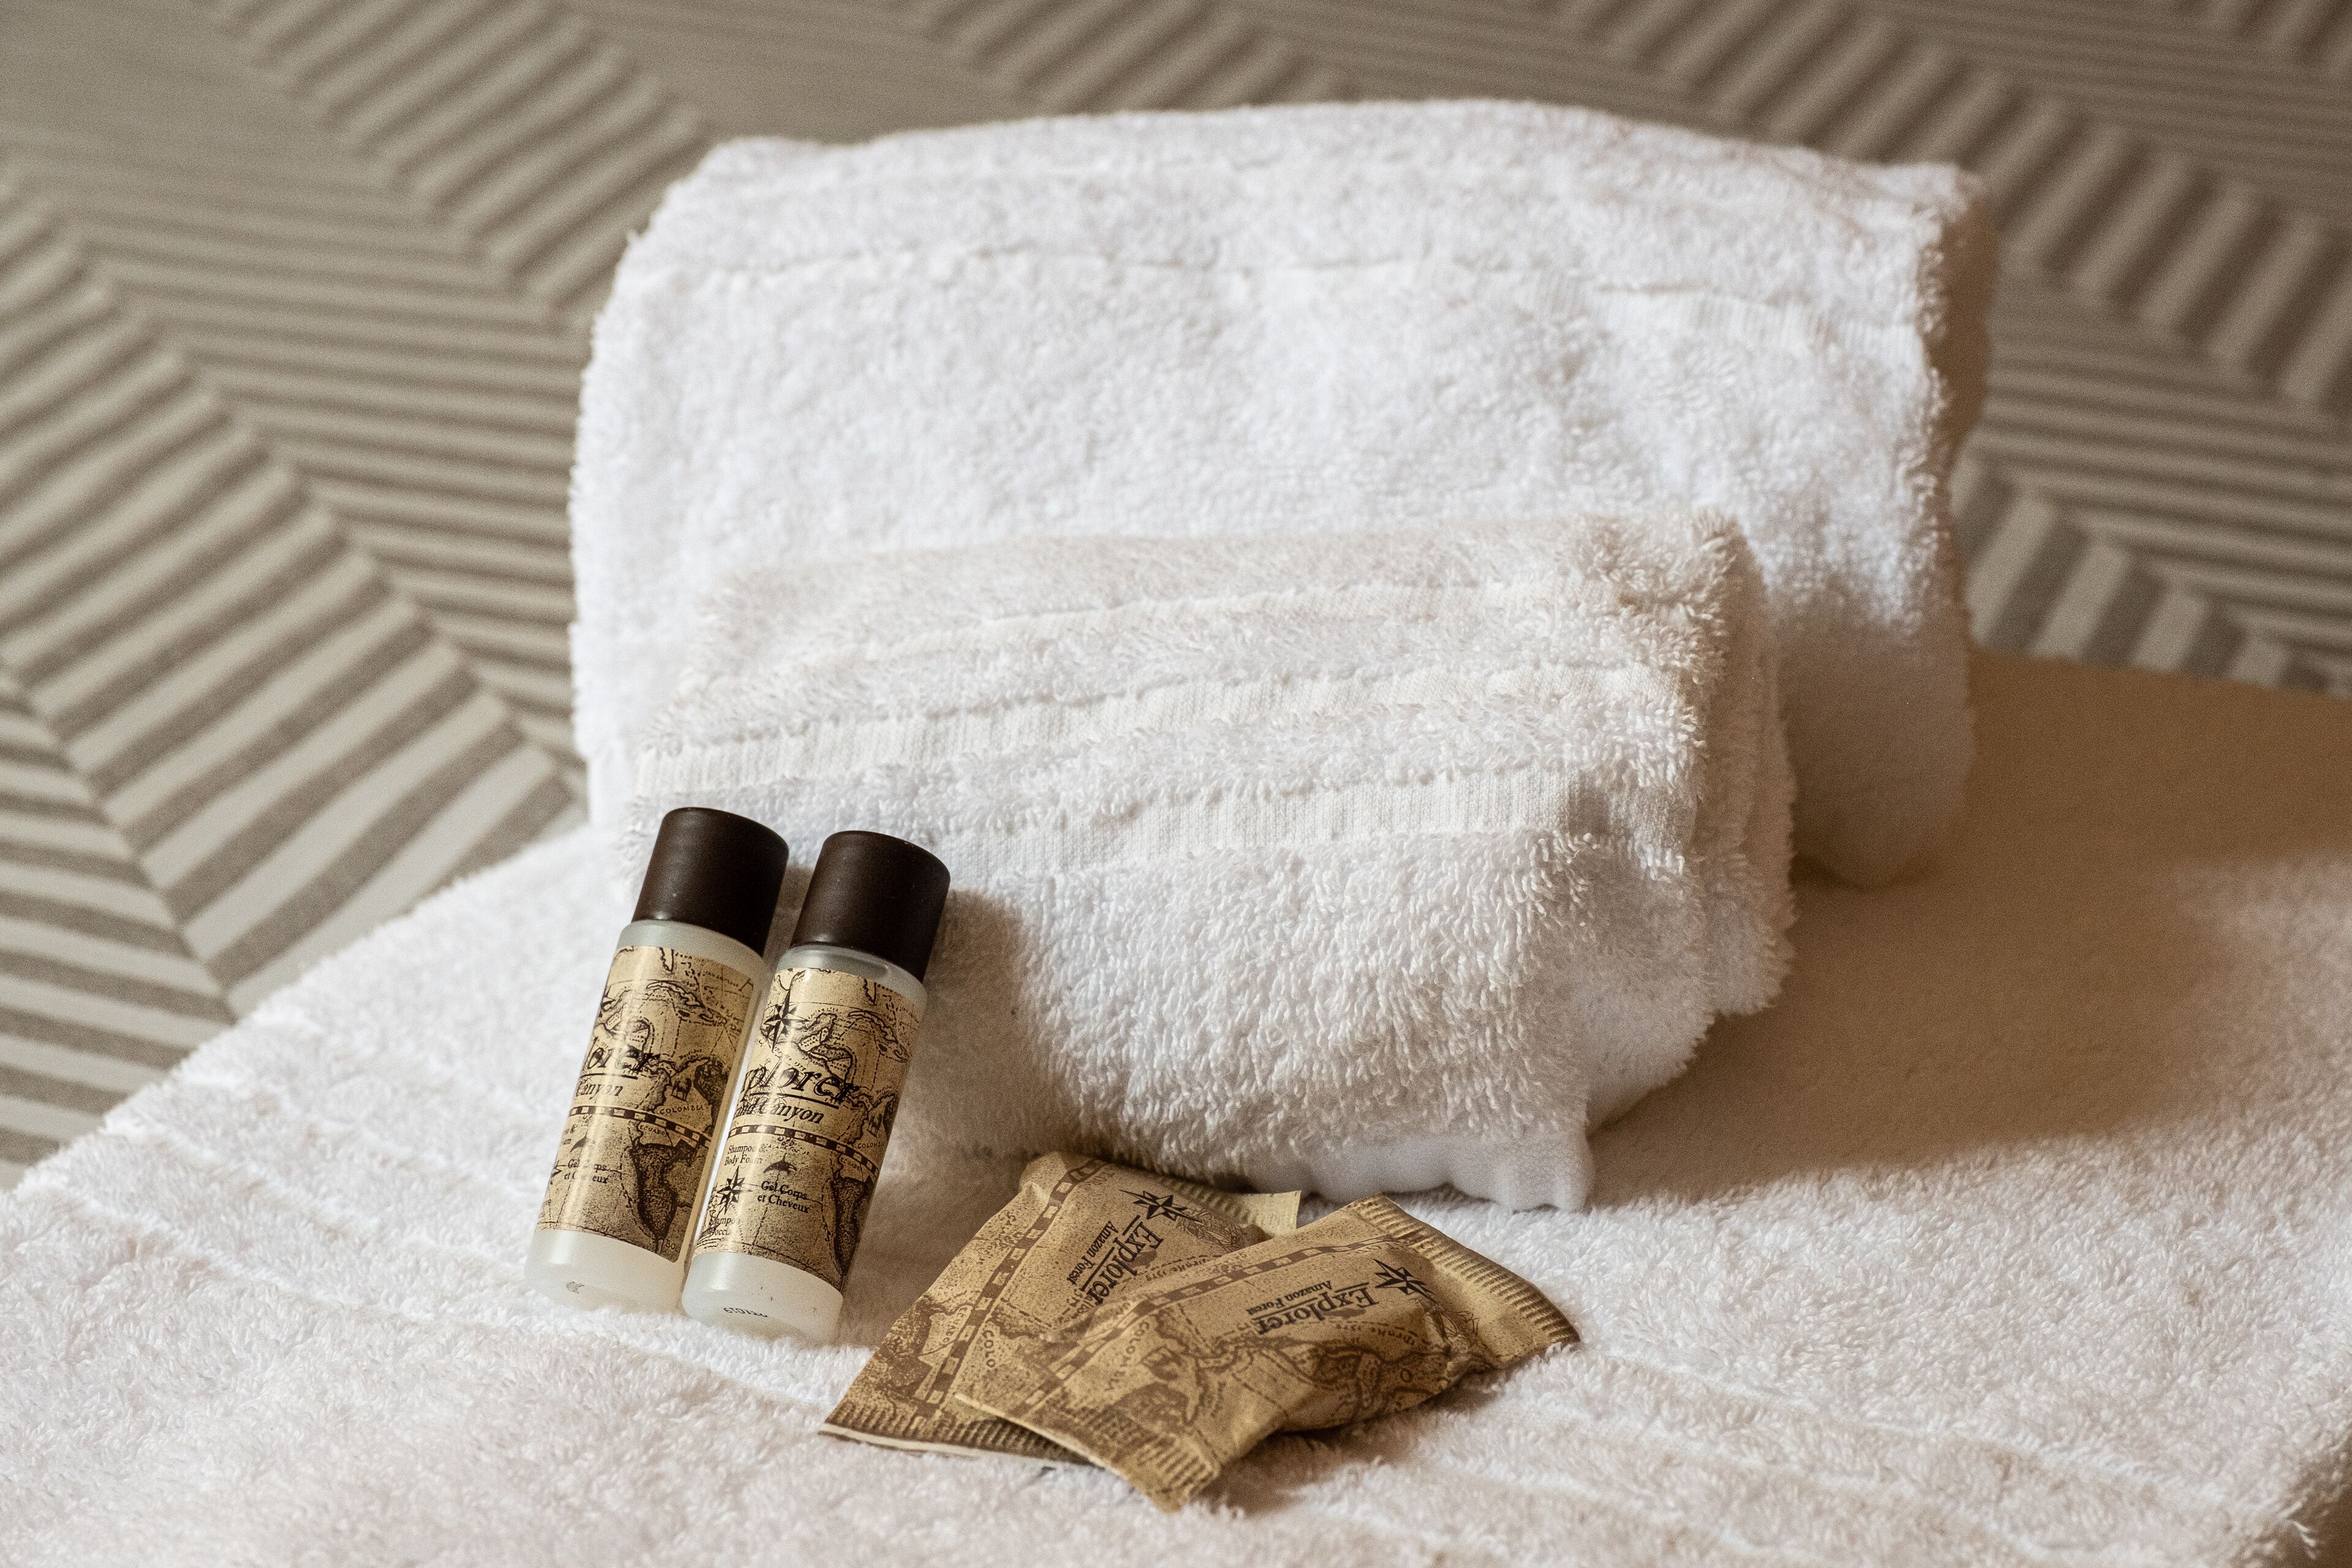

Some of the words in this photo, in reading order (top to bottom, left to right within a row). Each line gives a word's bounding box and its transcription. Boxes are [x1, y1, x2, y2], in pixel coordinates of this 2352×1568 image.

[660, 1104, 704, 1114] COLOMBIA
[759, 1100, 824, 1124] Canyon
[728, 1144, 756, 1154] Shampoo
[724, 1155, 739, 1166] Body
[761, 1180, 778, 1192] Gel
[780, 1184, 807, 1200] Corps
[768, 1194, 809, 1213] Cheveux
[1086, 1221, 1119, 1257] Amazon
[1066, 1256, 1096, 1286] Forest
[1087, 1221, 1164, 1304] Explorer
[1284, 1281, 1333, 1302] Amazon
[1246, 1298, 1285, 1316] Forest
[1256, 1287, 1379, 1335] Explorer
